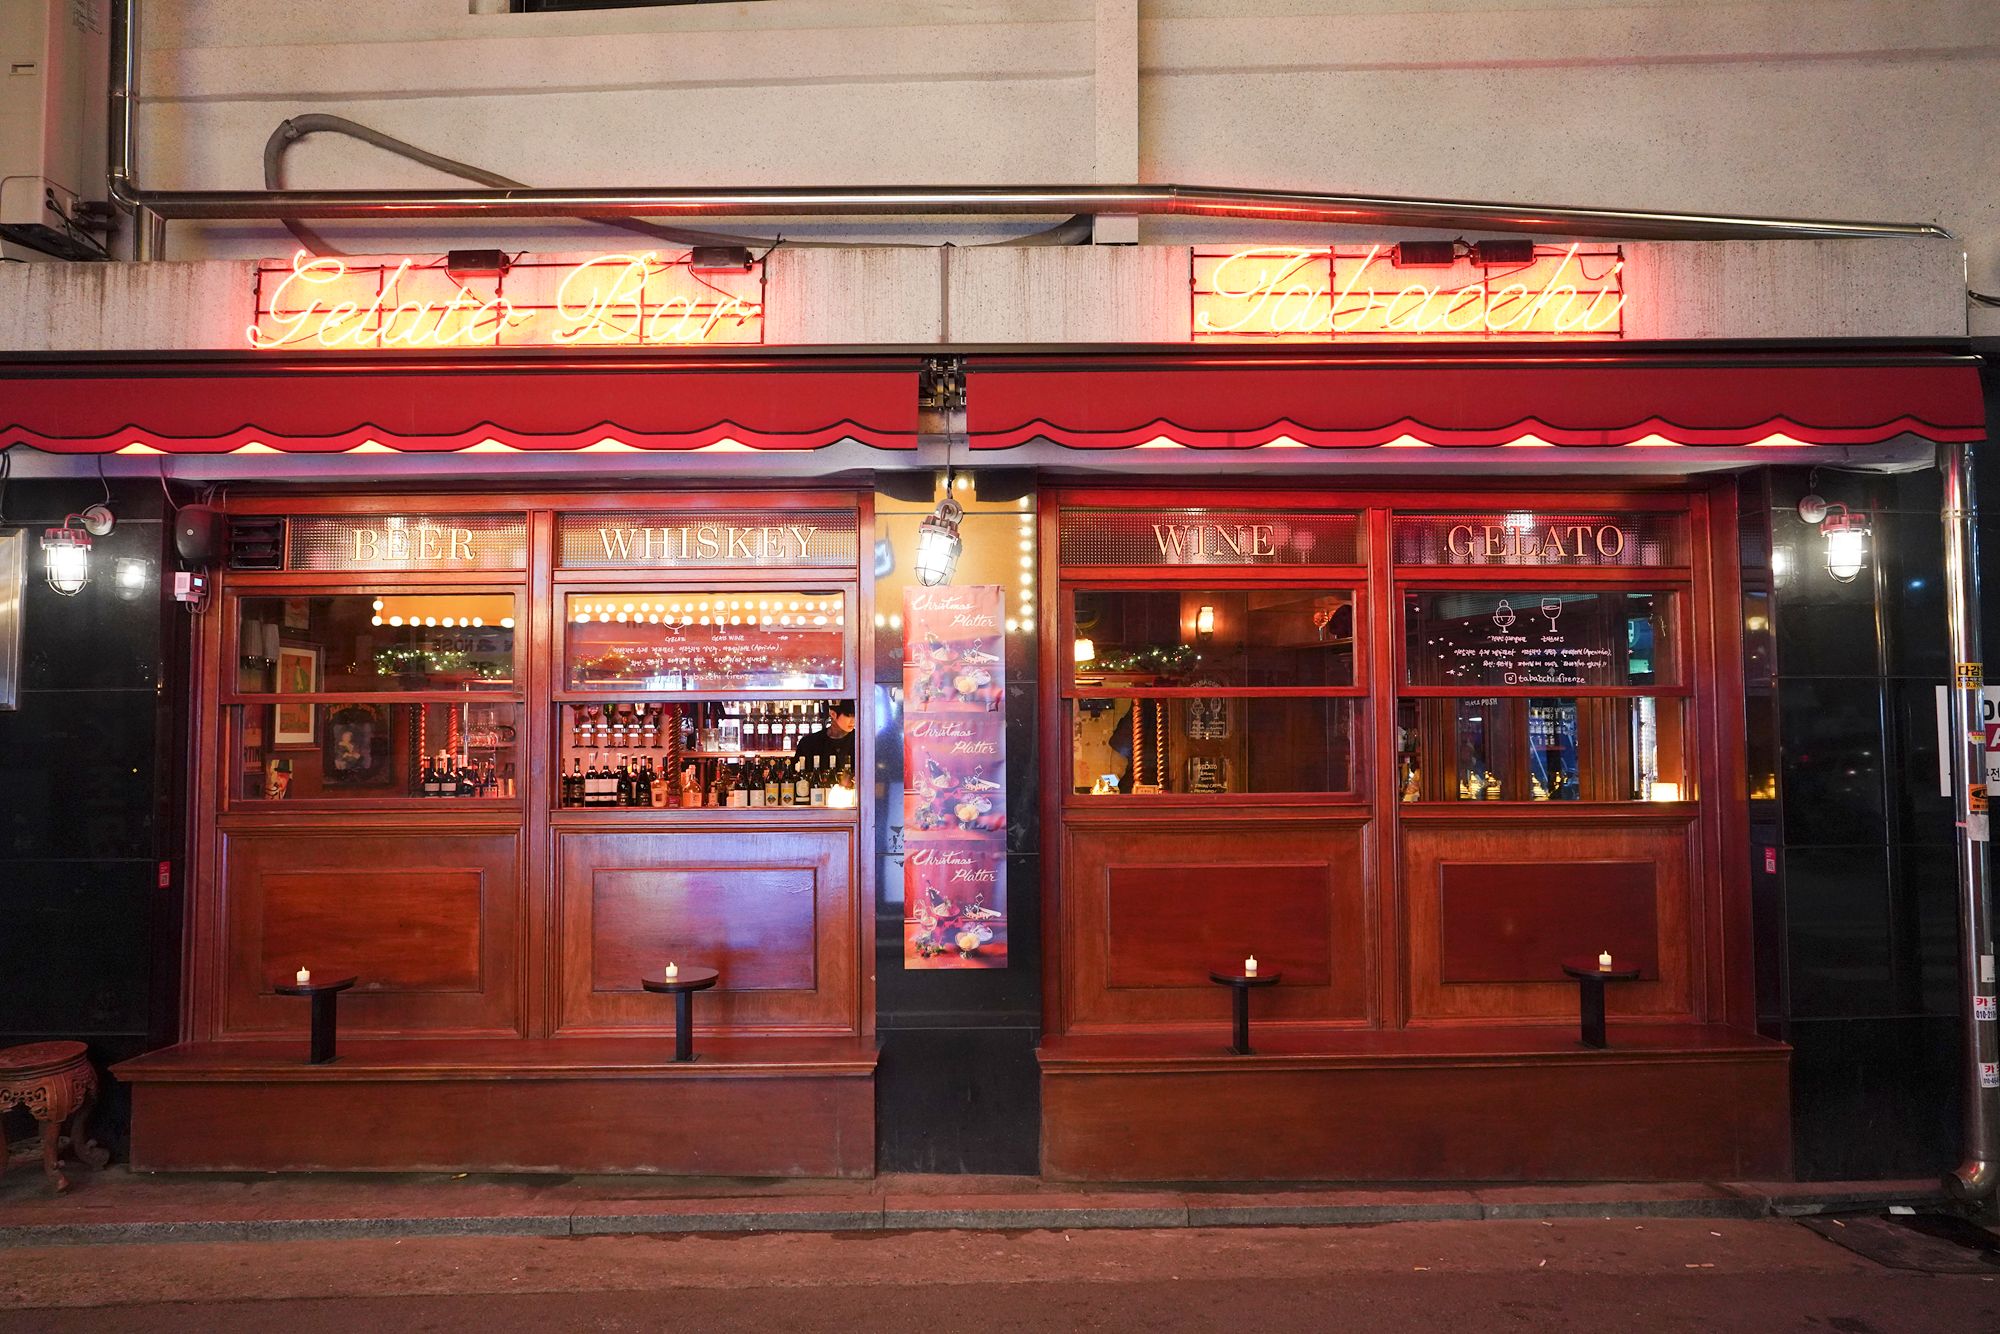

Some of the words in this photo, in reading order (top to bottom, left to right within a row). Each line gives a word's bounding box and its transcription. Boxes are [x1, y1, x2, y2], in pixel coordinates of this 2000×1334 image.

[247, 249, 535, 348] Gelato
[554, 252, 761, 345] Bar
[1197, 242, 1628, 333] Tabacchi
[350, 526, 476, 562] BEER
[598, 525, 819, 562] WHISKEY
[1152, 524, 1276, 558] WINE
[1447, 524, 1625, 559] GELATO
[911, 594, 977, 612] Christmas
[949, 613, 997, 629] Platter
[912, 719, 977, 738] Christmas
[950, 740, 998, 755] Platter
[912, 848, 977, 867] Christmas
[950, 868, 998, 884] Platter
